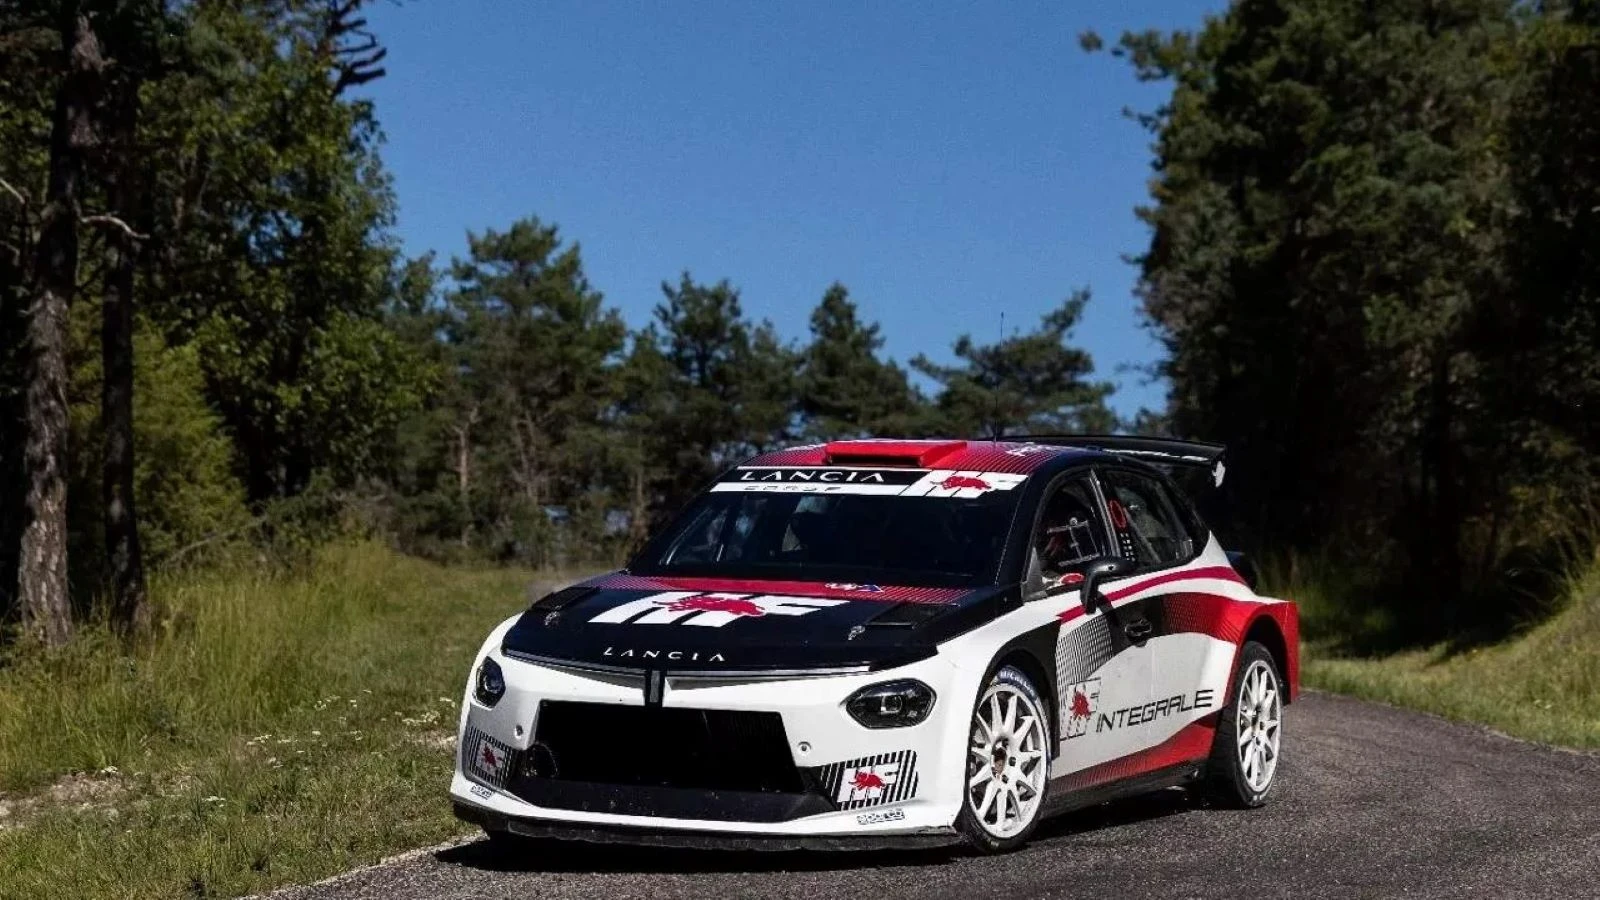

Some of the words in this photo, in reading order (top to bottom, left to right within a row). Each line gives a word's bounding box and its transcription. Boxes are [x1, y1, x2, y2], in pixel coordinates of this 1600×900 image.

[740, 470, 885, 483] LANCIA
[603, 646, 726, 662] LANCIA
[1096, 689, 1214, 733] INTEGRALE
